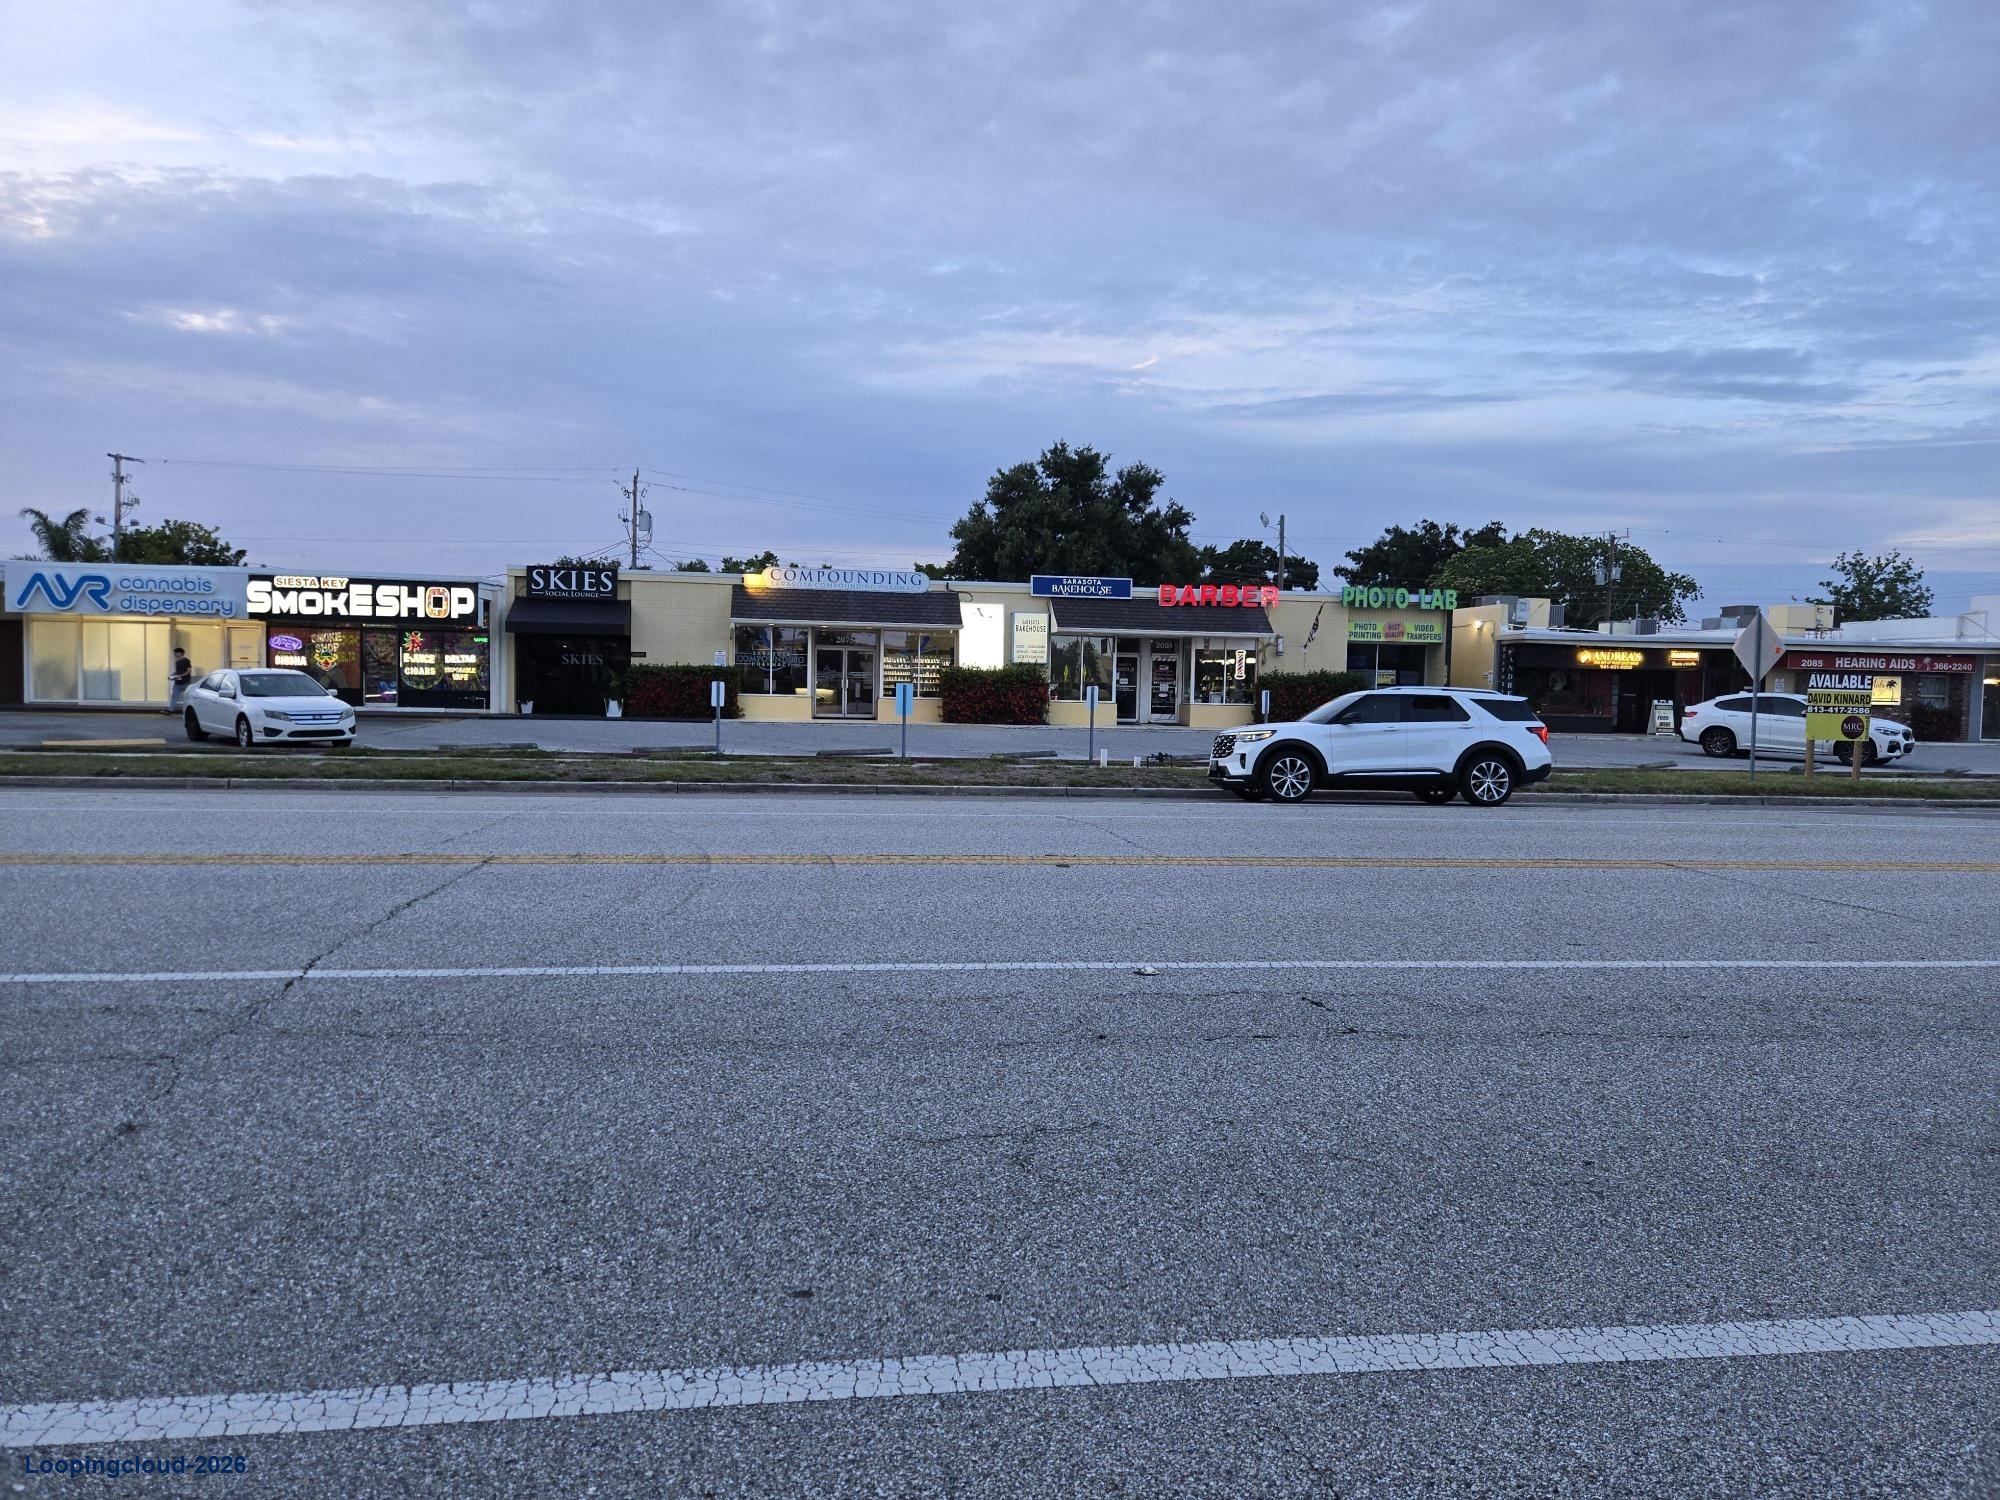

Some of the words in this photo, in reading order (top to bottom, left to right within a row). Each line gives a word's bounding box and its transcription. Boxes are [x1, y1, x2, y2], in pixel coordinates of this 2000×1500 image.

[531, 569, 613, 592] SKIES
[770, 568, 922, 586] COMPOUNDING
[120, 576, 212, 592] cannabis
[276, 578, 317, 587] SIESTA
[322, 578, 346, 588] KEY
[16, 572, 110, 610] AYR
[1052, 585, 1112, 595] BAKEHOUSE
[1158, 584, 1279, 608] BARBER
[1342, 586, 1409, 609] PHOTO
[1419, 588, 1458, 610] LAB
[120, 595, 233, 616] dispensary
[1354, 623, 1377, 631] PHOTO
[1414, 624, 1434, 632] VIDEO
[311, 632, 342, 642] SMOKE
[1407, 632, 1441, 640] TRANSFERS
[562, 654, 603, 665] SKIES
[1801, 659, 1823, 667] 2085
[1835, 657, 1887, 669] HEARING
[1889, 658, 1916, 670] AIDS
[404, 667, 436, 675] CIGARS
[1808, 674, 1872, 689] AVAILABLE
[1808, 693, 1831, 704] DAVID
[1834, 694, 1871, 705] KINNARD
[1808, 706, 1870, 714] 813-417-2586
[1843, 723, 1862, 731] MRC
